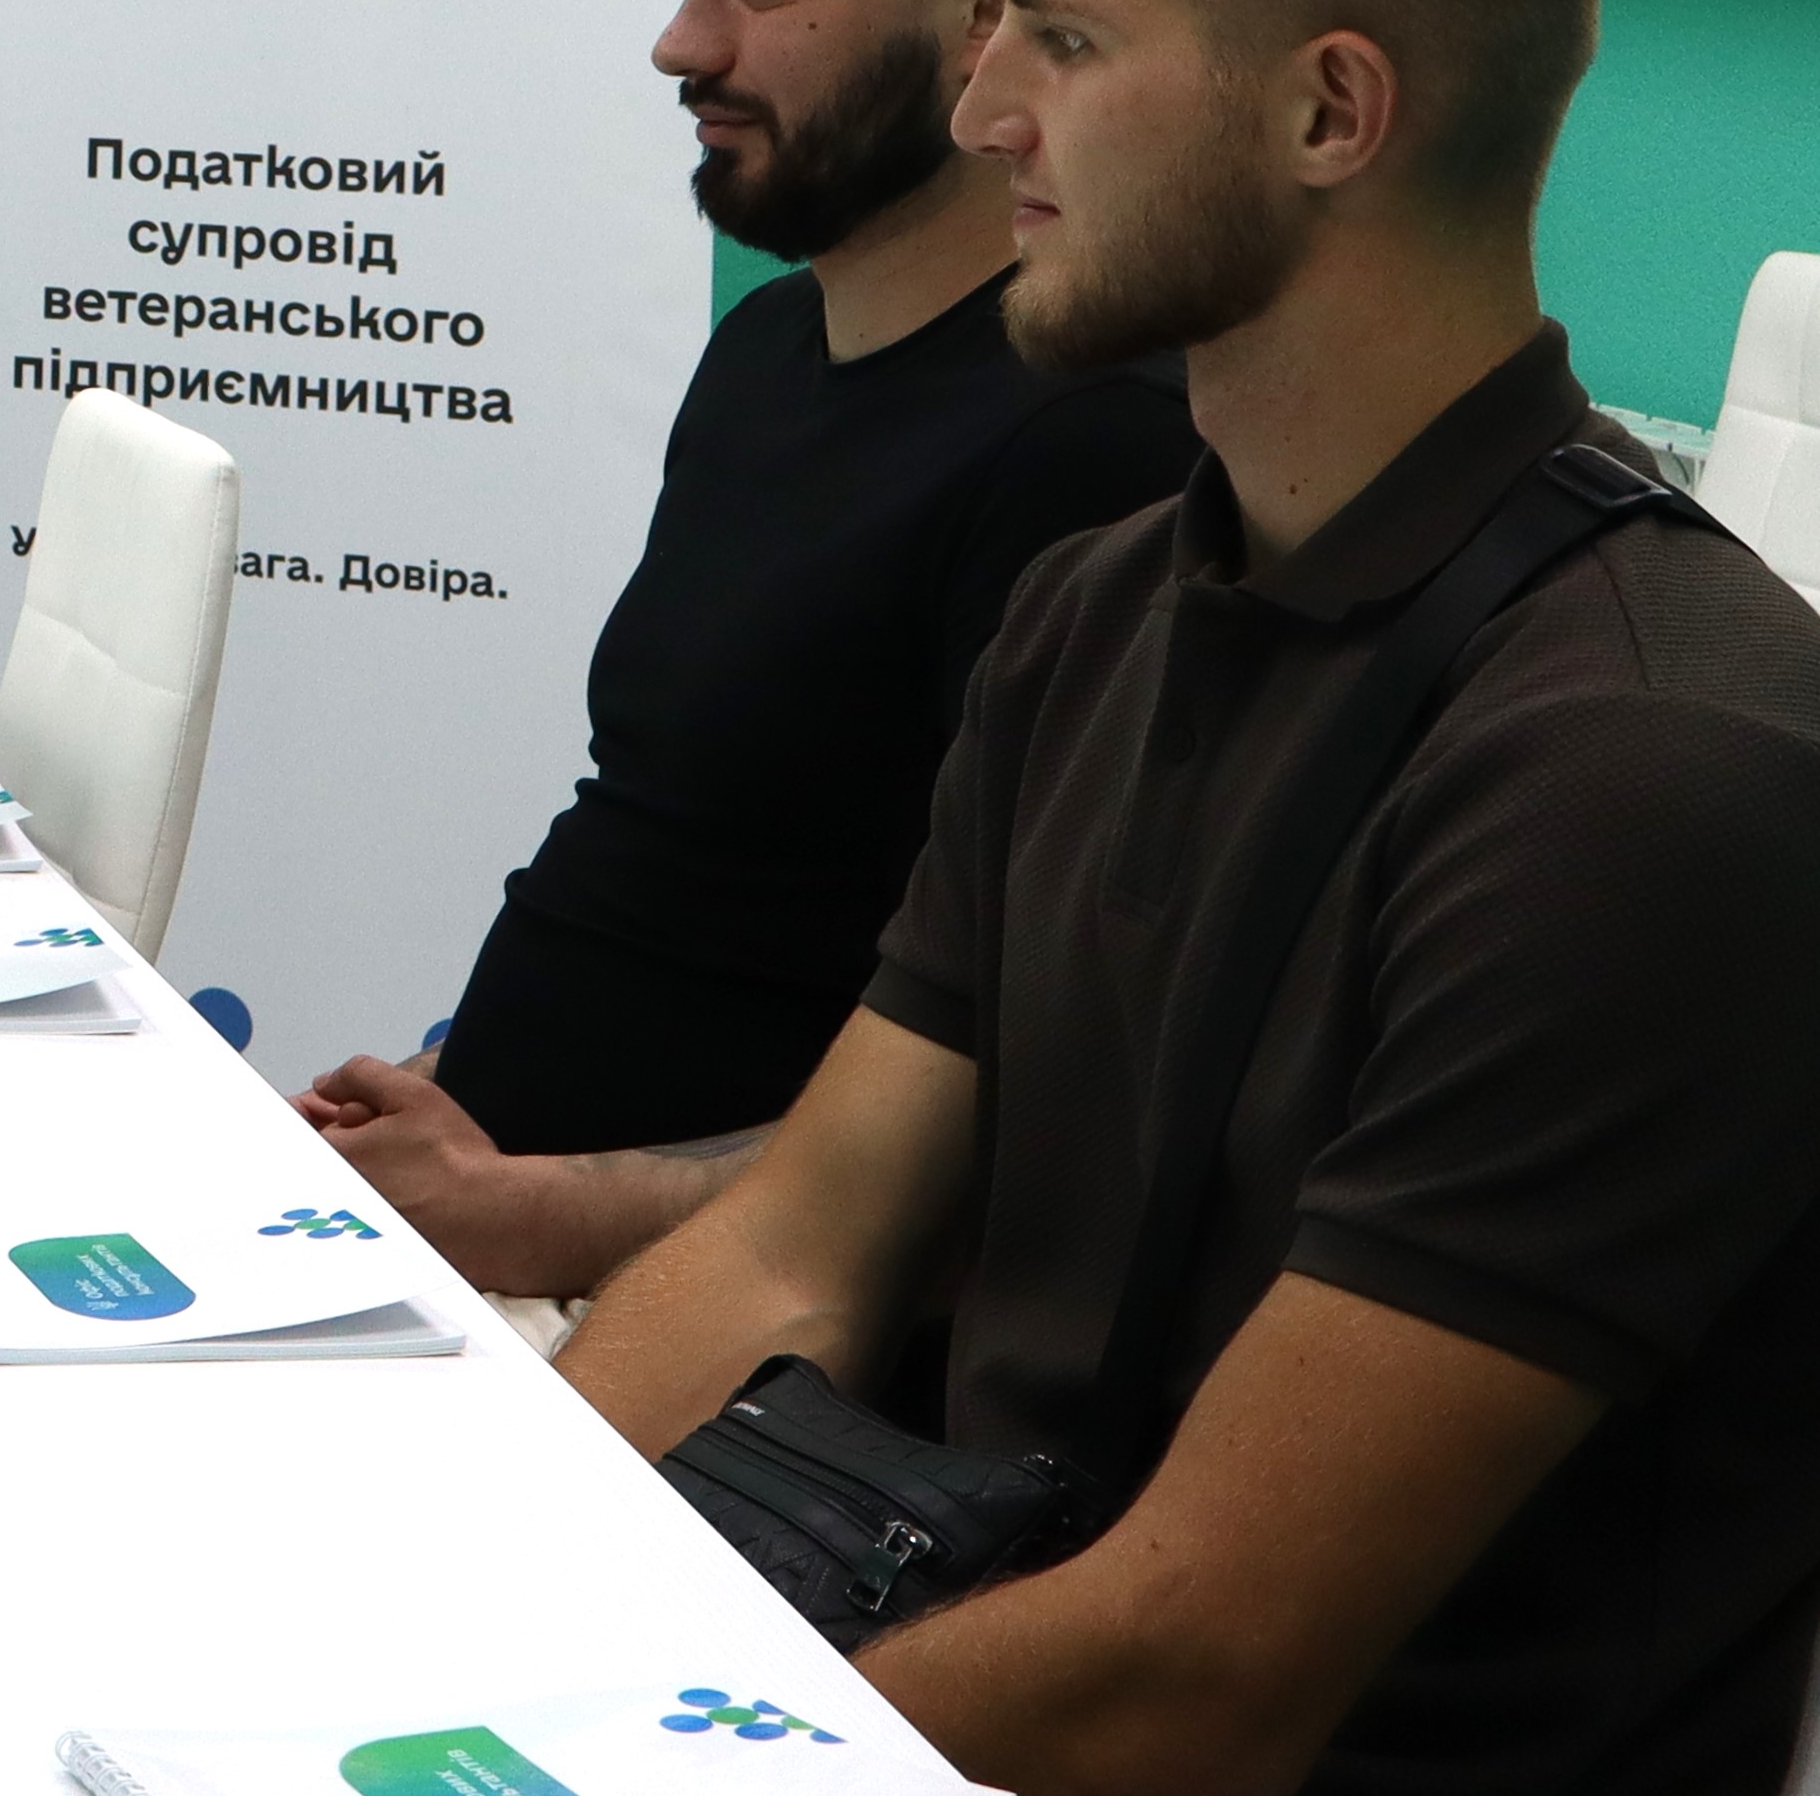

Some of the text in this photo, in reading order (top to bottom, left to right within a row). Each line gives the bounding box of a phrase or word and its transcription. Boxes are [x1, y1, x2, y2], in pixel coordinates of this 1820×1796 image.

[86, 136, 446, 197] Податковий
[127, 219, 399, 275] супровід
[43, 285, 486, 348] ветеранського
[12, 347, 514, 425] підприємництва
[338, 552, 509, 603] Довіра.
